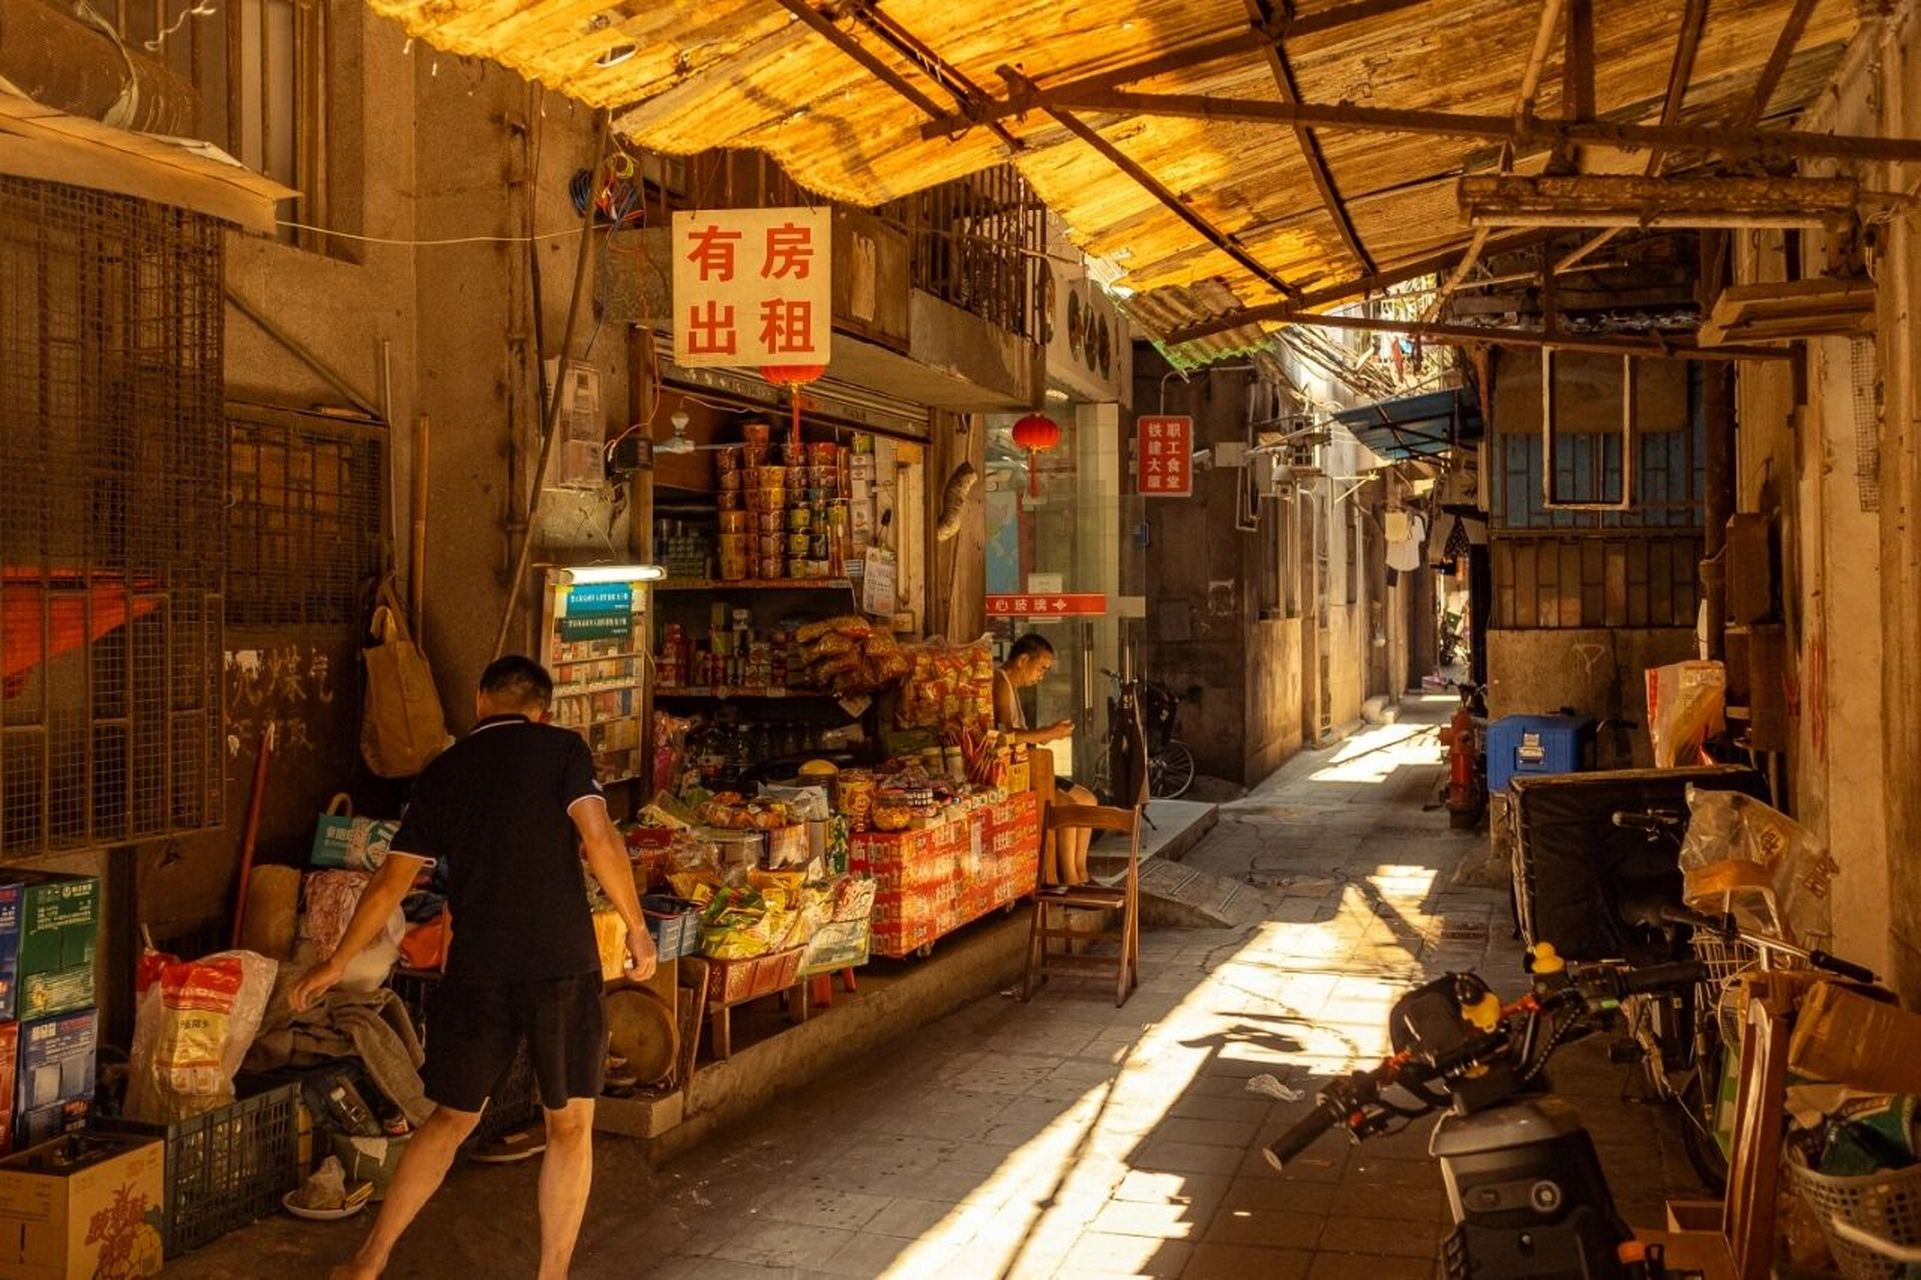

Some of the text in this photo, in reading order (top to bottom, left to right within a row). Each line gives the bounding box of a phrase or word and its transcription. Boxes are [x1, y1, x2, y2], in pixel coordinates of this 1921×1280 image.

[687, 223, 814, 282] 有房
[688, 298, 815, 355] 出租
[1166, 422, 1181, 489] 职工食堂
[985, 598, 1047, 612] 心玻璃
